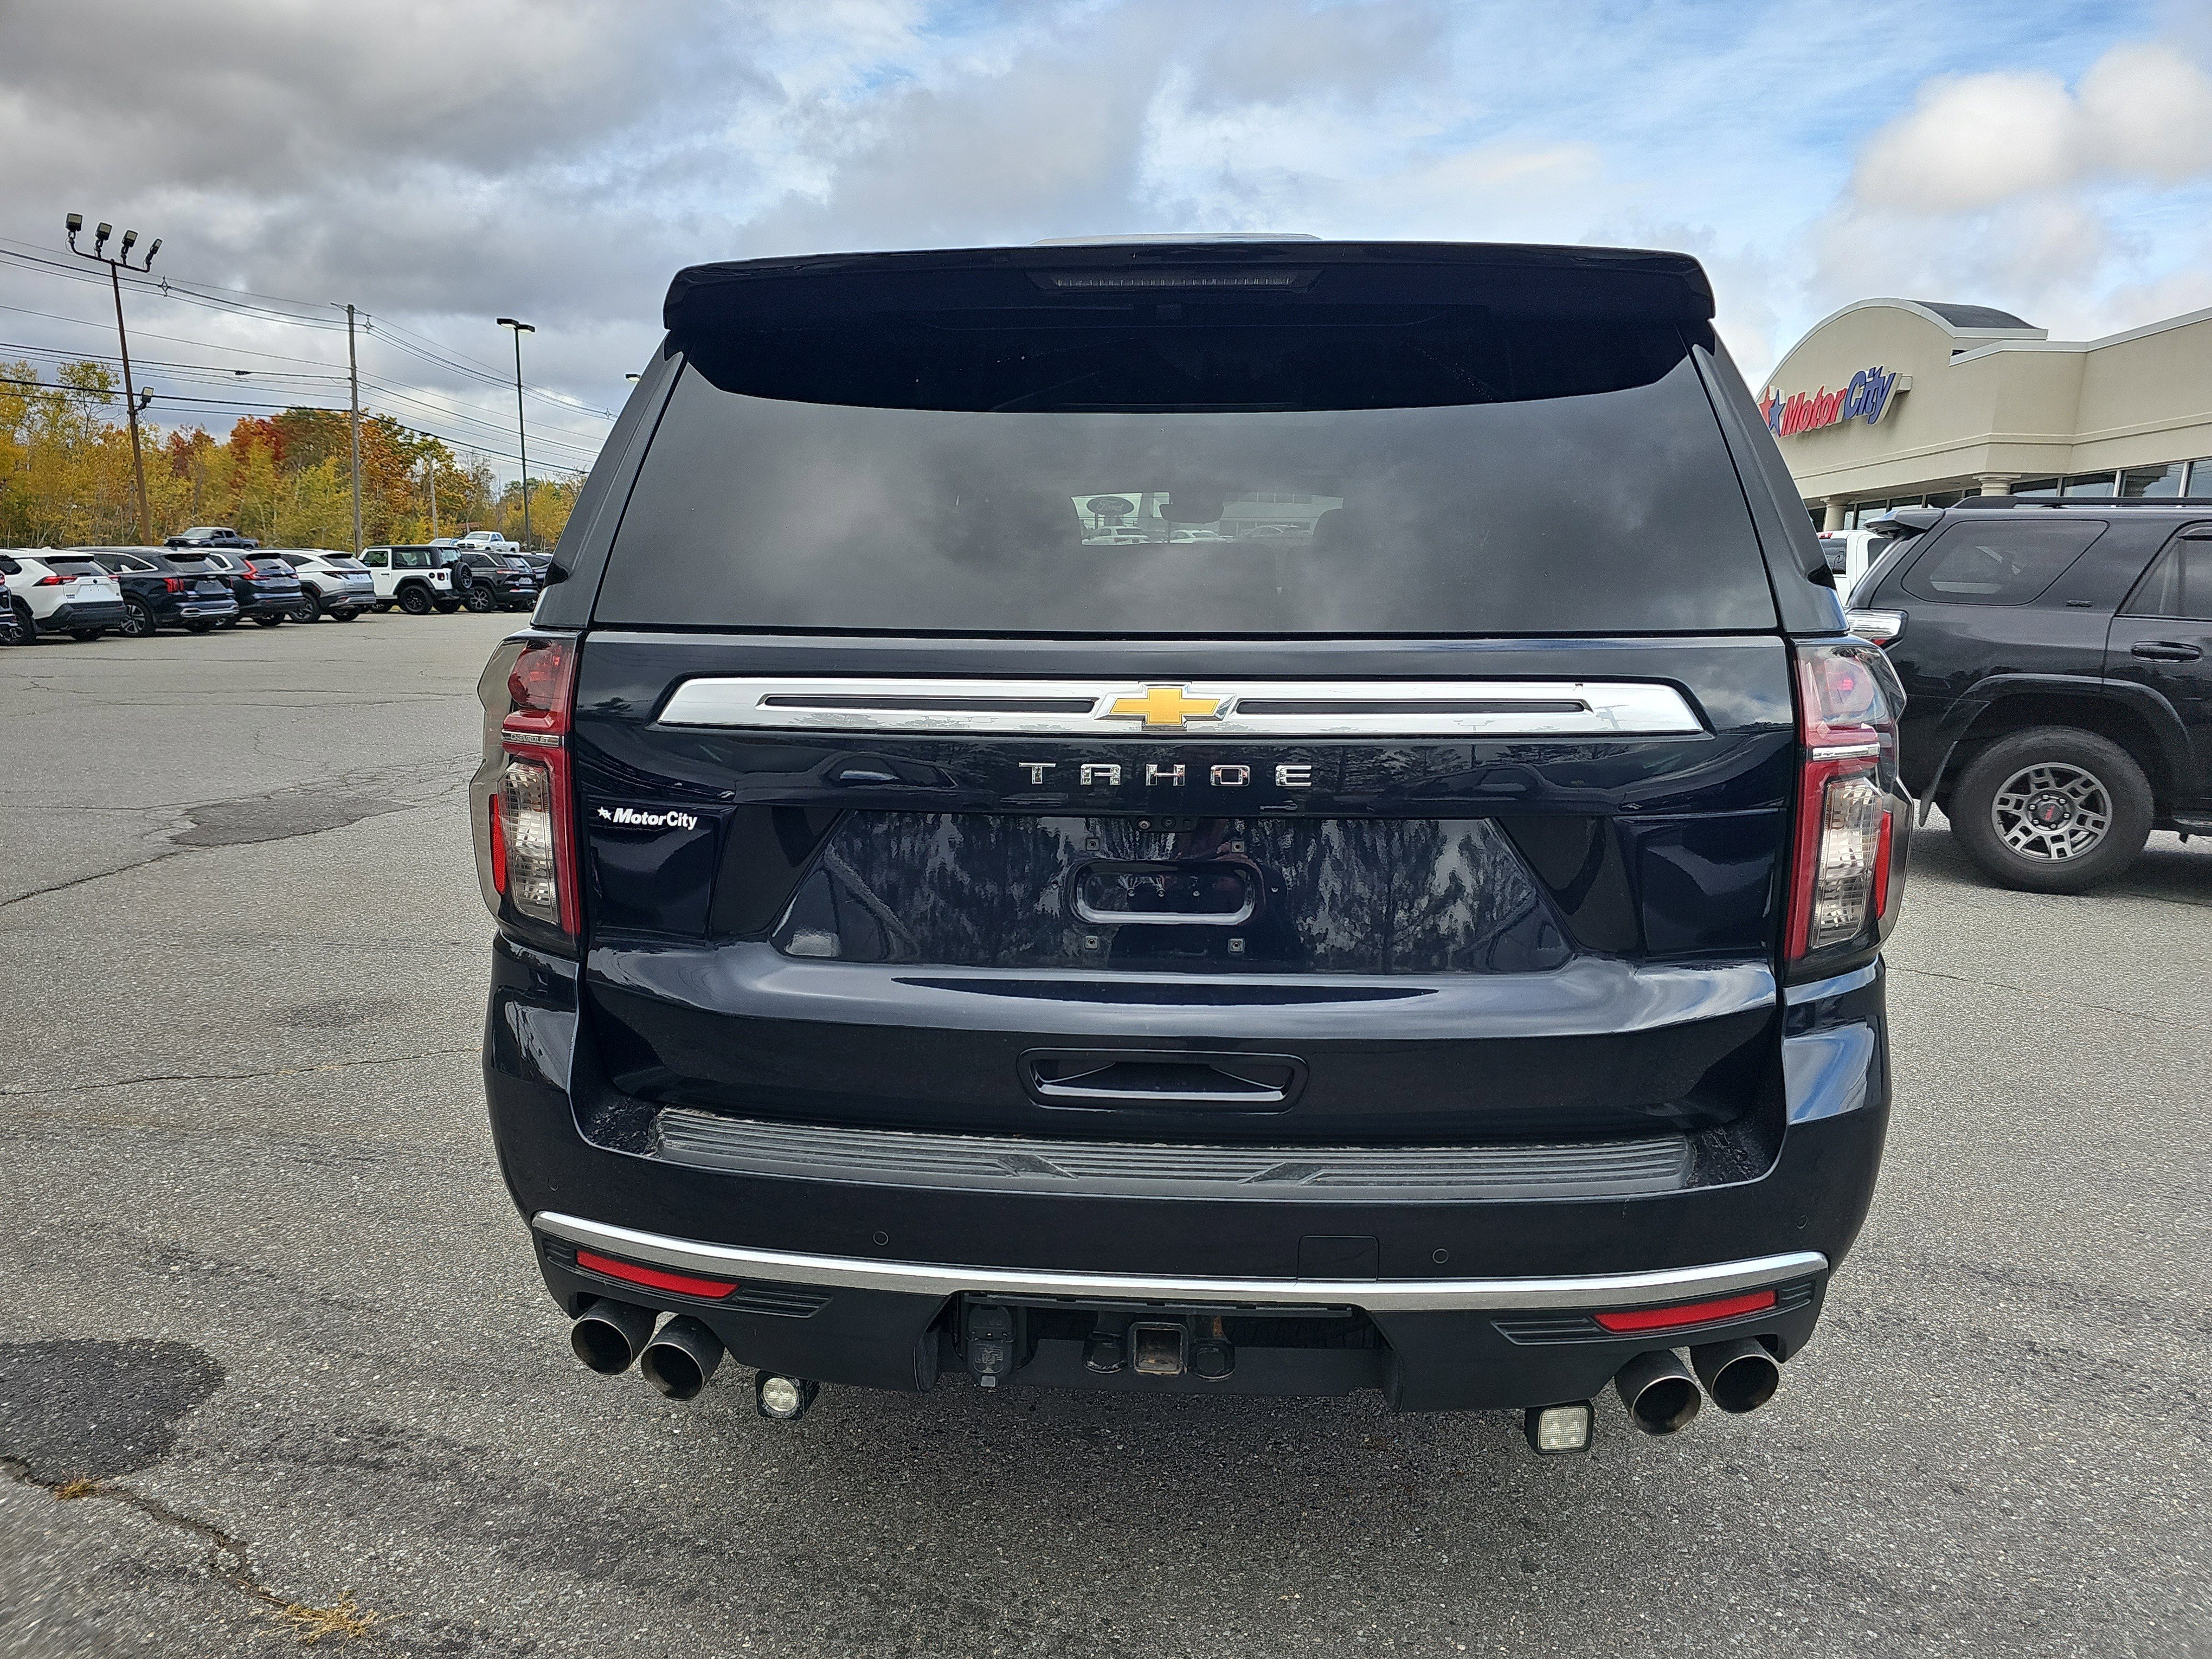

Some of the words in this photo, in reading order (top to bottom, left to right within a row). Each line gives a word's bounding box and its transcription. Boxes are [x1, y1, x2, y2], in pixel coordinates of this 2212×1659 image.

[1780, 365, 1898, 437] MotorCity
[510, 734, 550, 744] CHEVROLET
[1018, 762, 1312, 787] TAHOE
[613, 807, 698, 831] MotorCity
